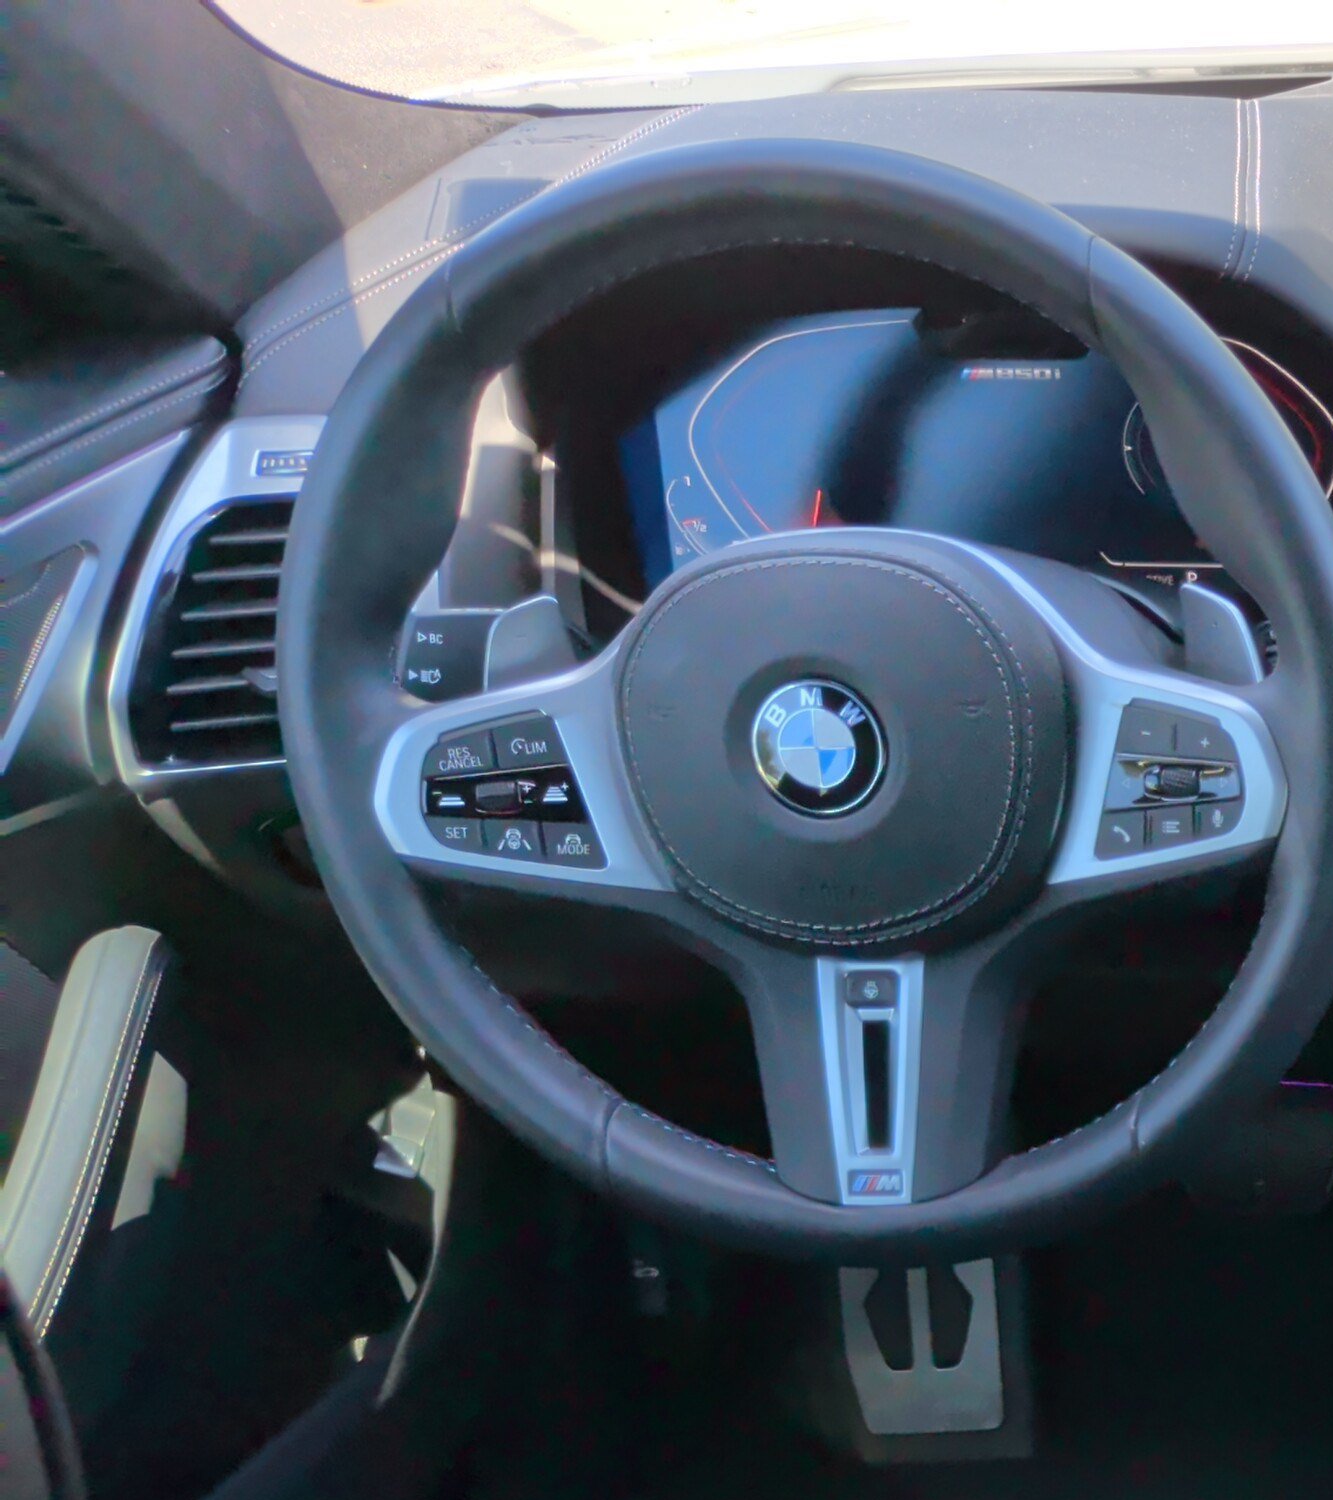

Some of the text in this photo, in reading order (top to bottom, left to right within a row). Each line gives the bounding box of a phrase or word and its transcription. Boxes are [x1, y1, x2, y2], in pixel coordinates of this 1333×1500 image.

[429, 633, 443, 644] BC
[764, 687, 866, 728] BMW
[525, 741, 547, 755] LIM
[439, 756, 484, 772] CANCEL
[445, 827, 467, 839] SET
[557, 844, 590, 855] MODE
